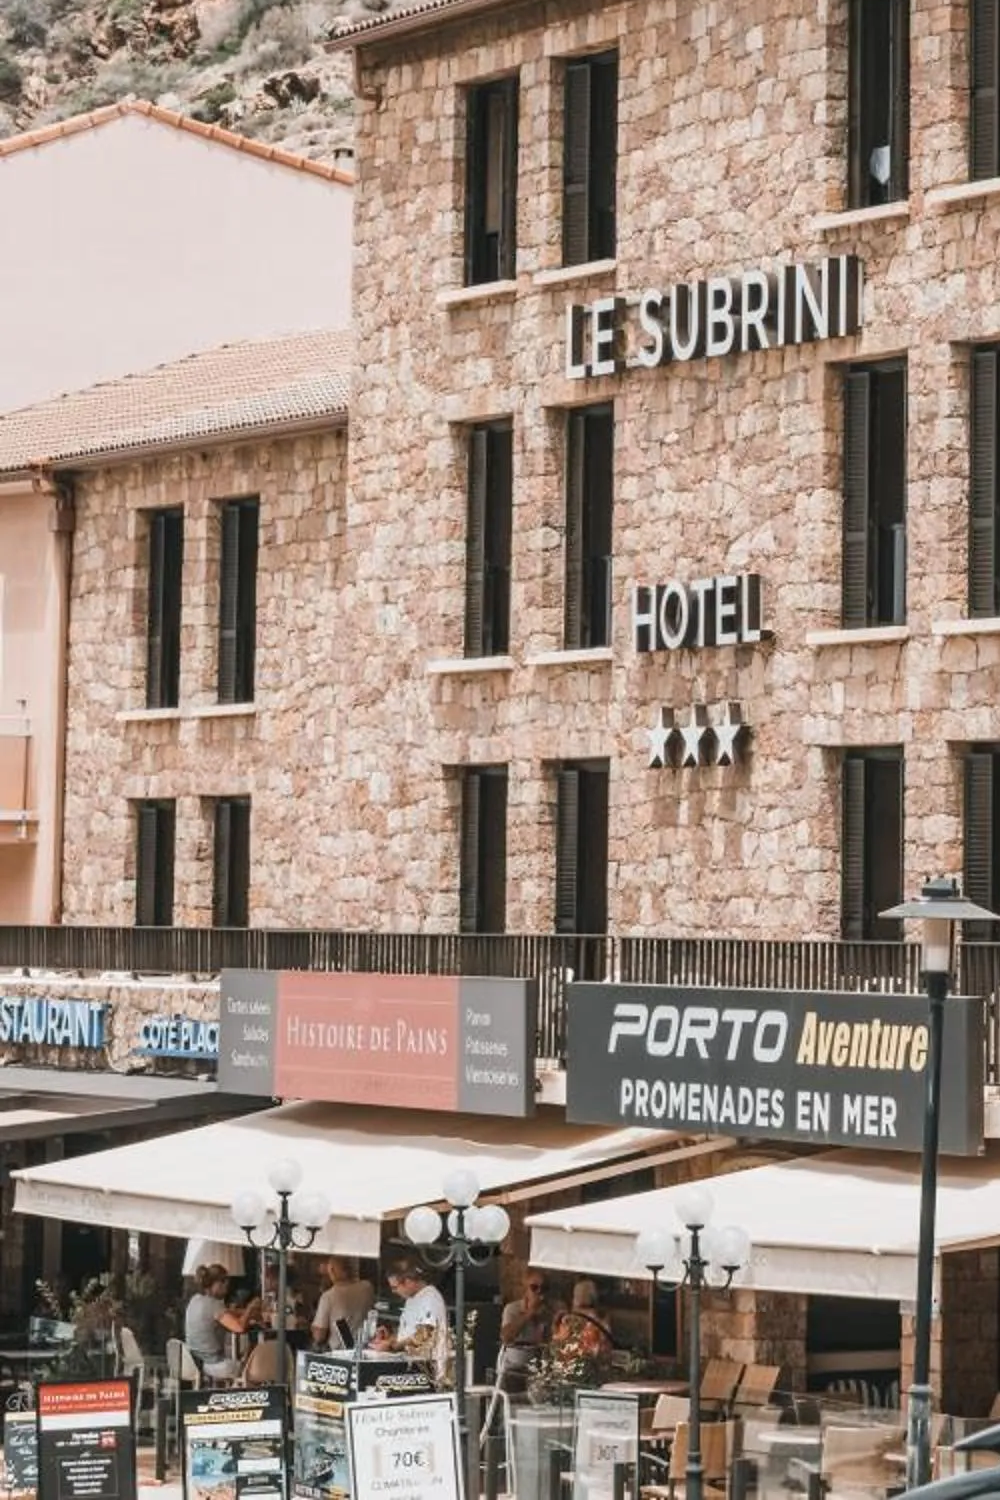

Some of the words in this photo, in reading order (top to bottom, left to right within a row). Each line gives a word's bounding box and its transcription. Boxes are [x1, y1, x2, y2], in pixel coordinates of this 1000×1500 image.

[566, 298, 620, 380] LE
[638, 254, 856, 369] SUBRINI
[631, 573, 765, 653] HOTEL
[287, 1016, 363, 1052] HISTOIRE
[370, 1028, 392, 1052] DE
[397, 1017, 448, 1056] PAINS
[608, 1003, 789, 1063] PORTO
[797, 1011, 930, 1073] Aventure
[619, 1078, 785, 1129] PROMENADES
[796, 1091, 830, 1135] EN
[842, 1094, 898, 1138] MER
[391, 1450, 426, 1469] 70€
